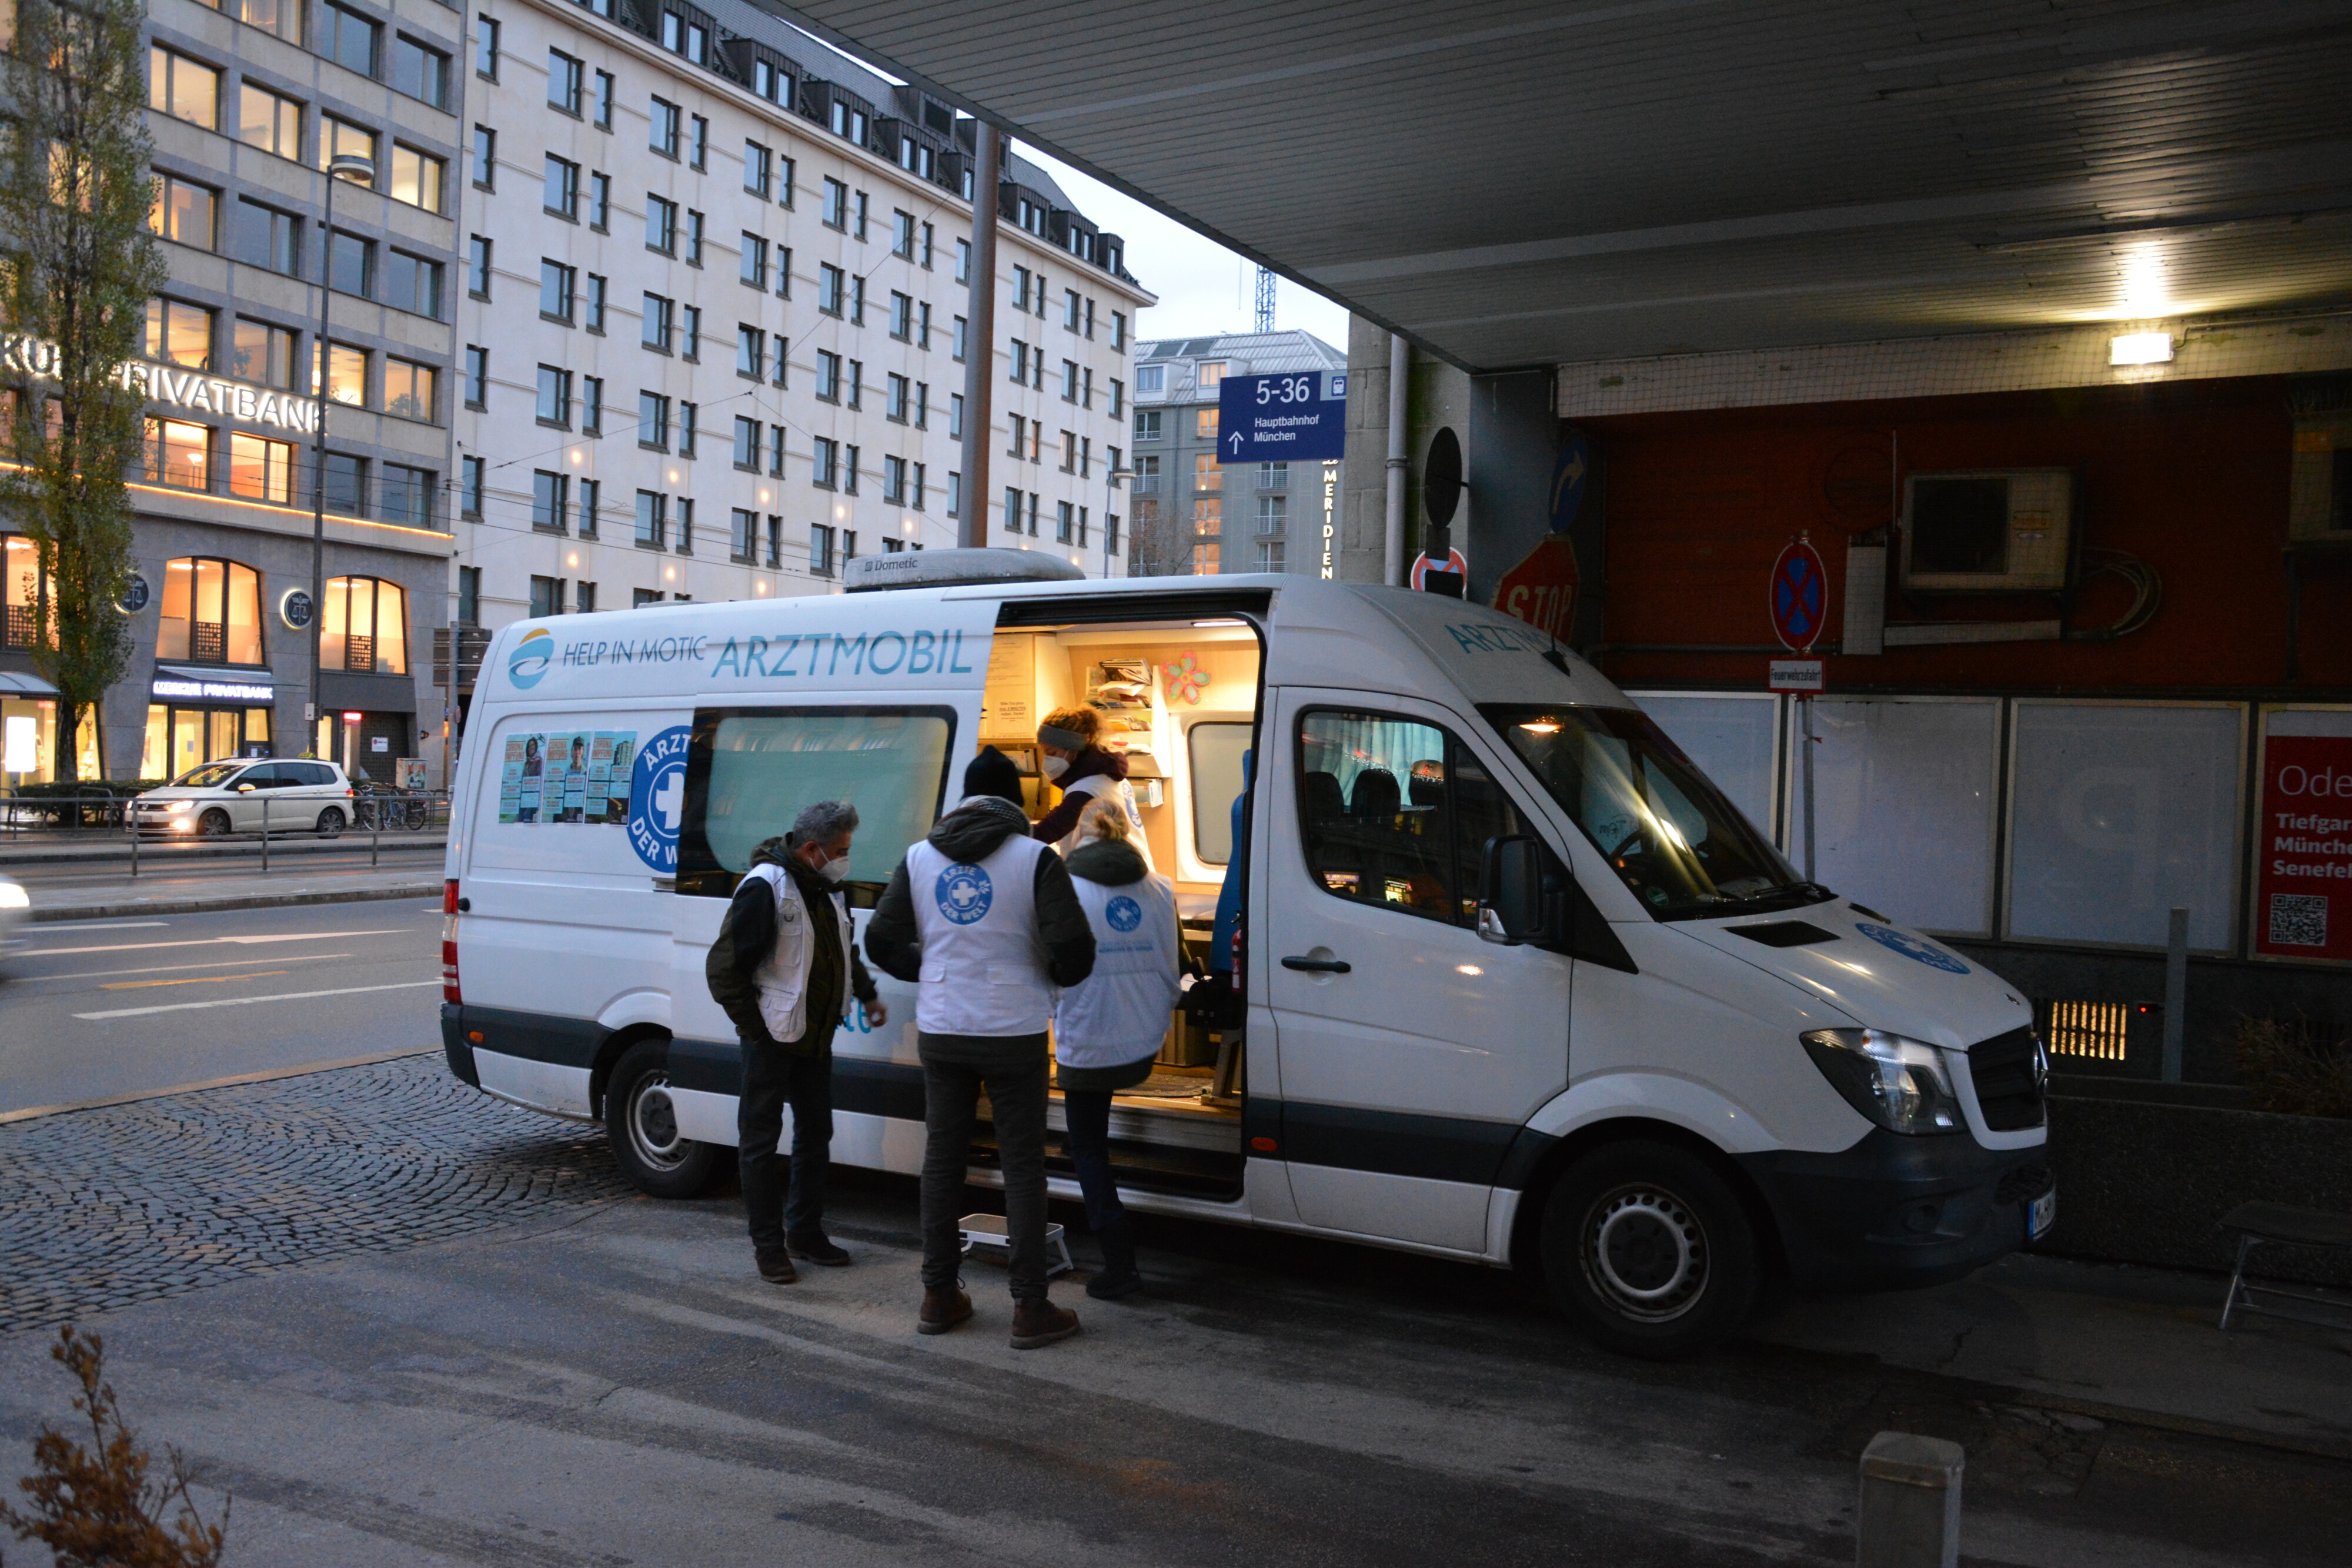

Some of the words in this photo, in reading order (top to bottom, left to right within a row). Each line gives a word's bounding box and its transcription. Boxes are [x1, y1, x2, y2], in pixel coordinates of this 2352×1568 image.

[1256, 377, 1310, 404] 5-36
[1254, 414, 1319, 429] Hauptbahnhof
[1254, 431, 1296, 442] München
[1321, 469, 1337, 580] MERIDIEN
[874, 557, 918, 571] Dometic
[1506, 583, 1572, 635] STOP
[563, 641, 607, 667] HELP
[612, 640, 635, 665] IN
[710, 628, 973, 678] ARZTMOBIL
[2278, 764, 2352, 798] Ode
[2275, 813, 2352, 834] Tiefgar
[631, 817, 660, 861] DER
